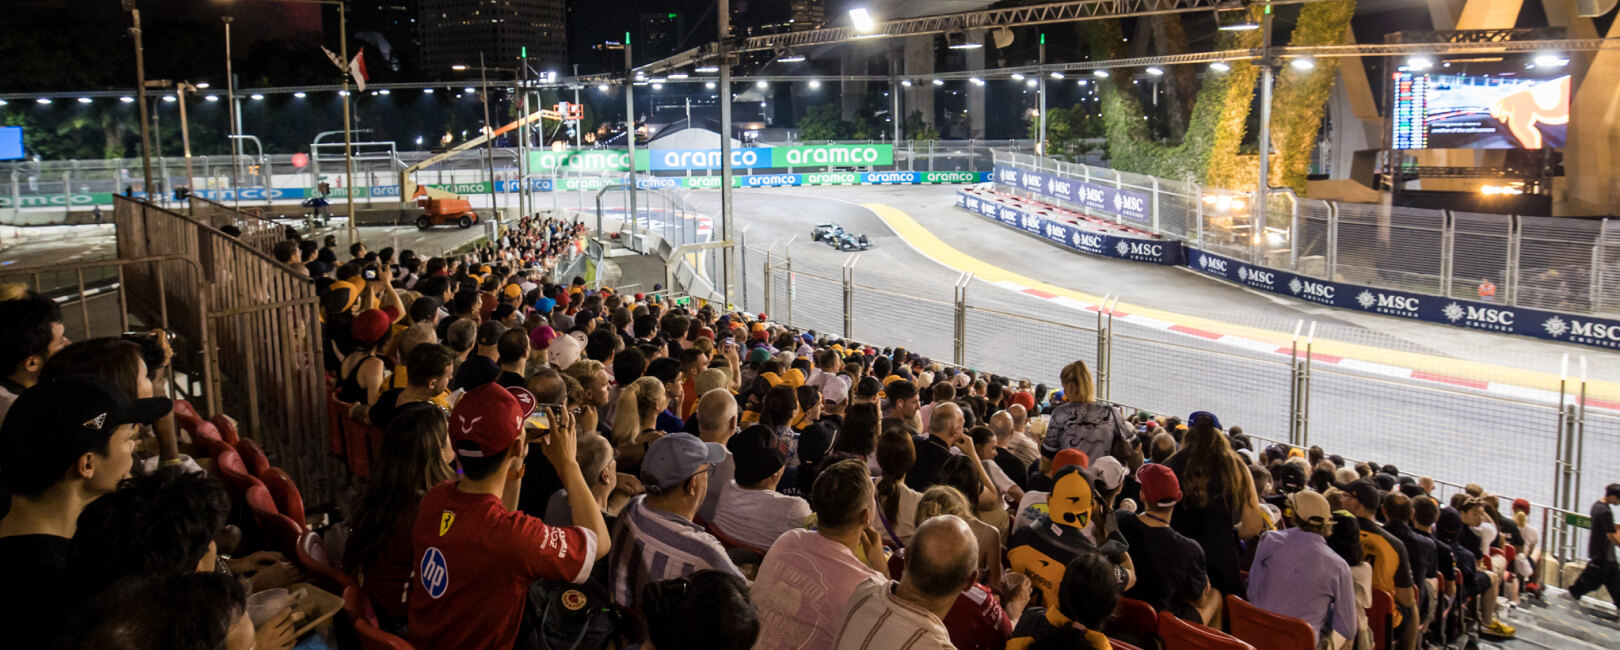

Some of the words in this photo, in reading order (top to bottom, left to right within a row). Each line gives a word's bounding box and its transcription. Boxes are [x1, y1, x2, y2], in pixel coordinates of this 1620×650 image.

[665, 150, 757, 167] aramco
[786, 147, 878, 164] aramco
[629, 178, 675, 187] ramco
[688, 178, 736, 187] aram
[749, 175, 796, 185] aramco
[808, 173, 855, 183] aramco
[868, 172, 914, 182] aramco
[928, 172, 973, 181] aramco
[1055, 180, 1071, 195] MSC
[1086, 187, 1105, 203] MSC
[1122, 195, 1143, 212] MSC
[1052, 224, 1066, 239] MSC
[1080, 233, 1102, 248] MSC
[1130, 242, 1162, 256] MSC
[1208, 256, 1227, 272] MSC
[1248, 268, 1275, 285] MSC
[1303, 281, 1335, 299] MSC
[1377, 293, 1419, 311] MSC
[1466, 306, 1514, 325] MSC
[1466, 321, 1514, 332] CRUISES
[1570, 320, 1620, 341] MSC
[423, 549, 445, 594] hp
[1024, 567, 1053, 590] NORRIS
